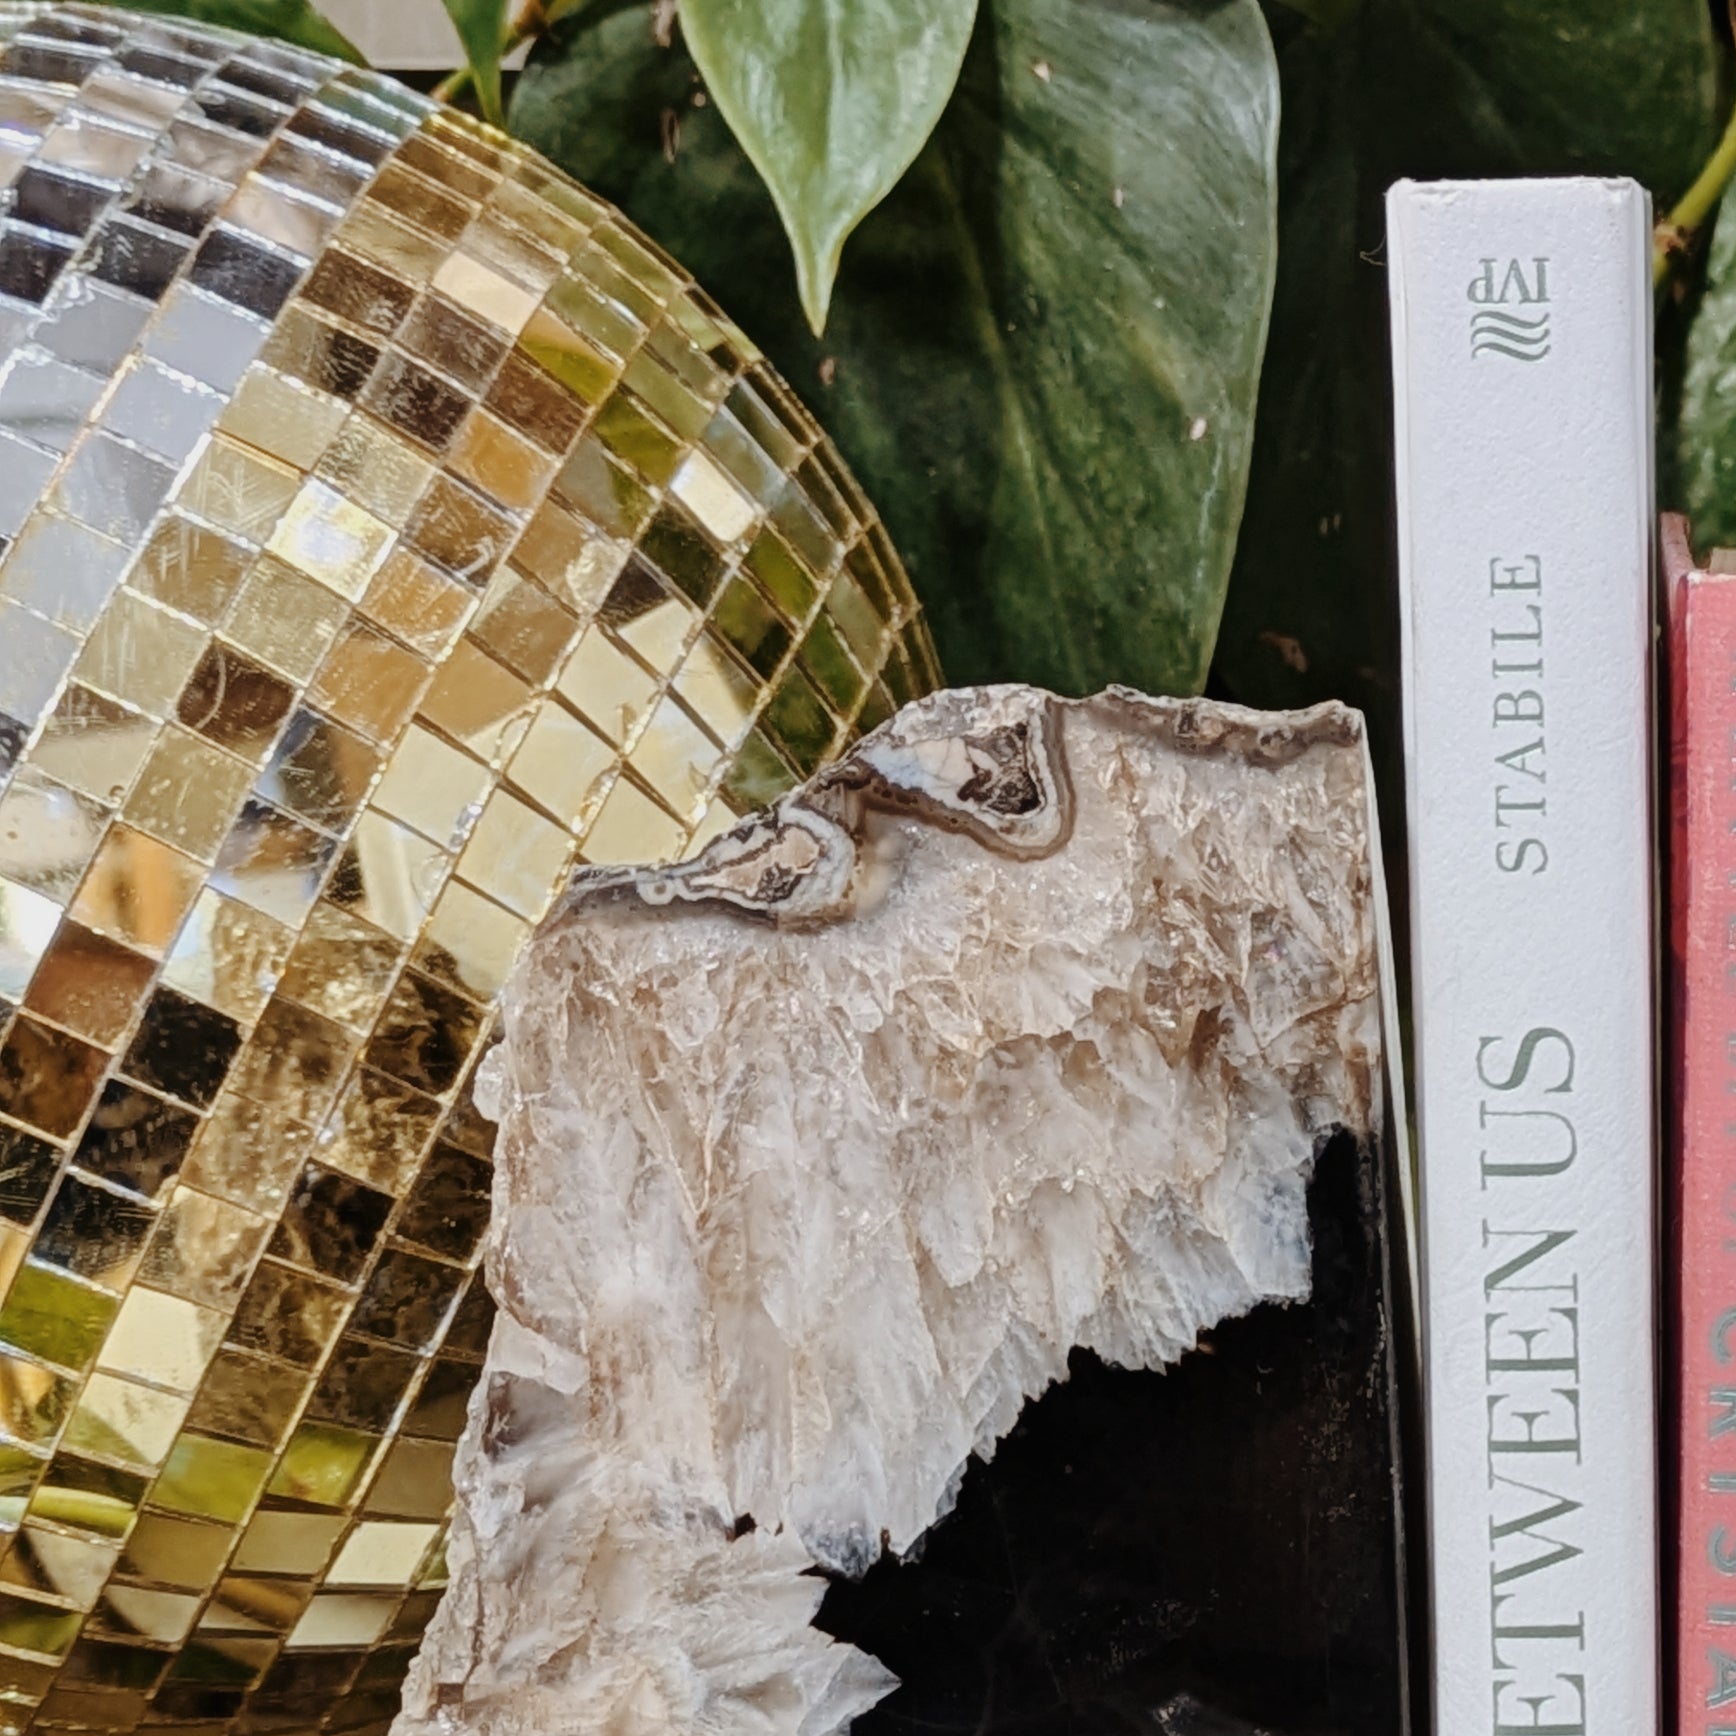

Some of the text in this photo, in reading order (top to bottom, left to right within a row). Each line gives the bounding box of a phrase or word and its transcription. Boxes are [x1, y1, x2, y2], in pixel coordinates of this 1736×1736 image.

[1467, 256, 1551, 304] IVP
[1488, 553, 1549, 875] STABILE
[1475, 1026, 1578, 1191] US
